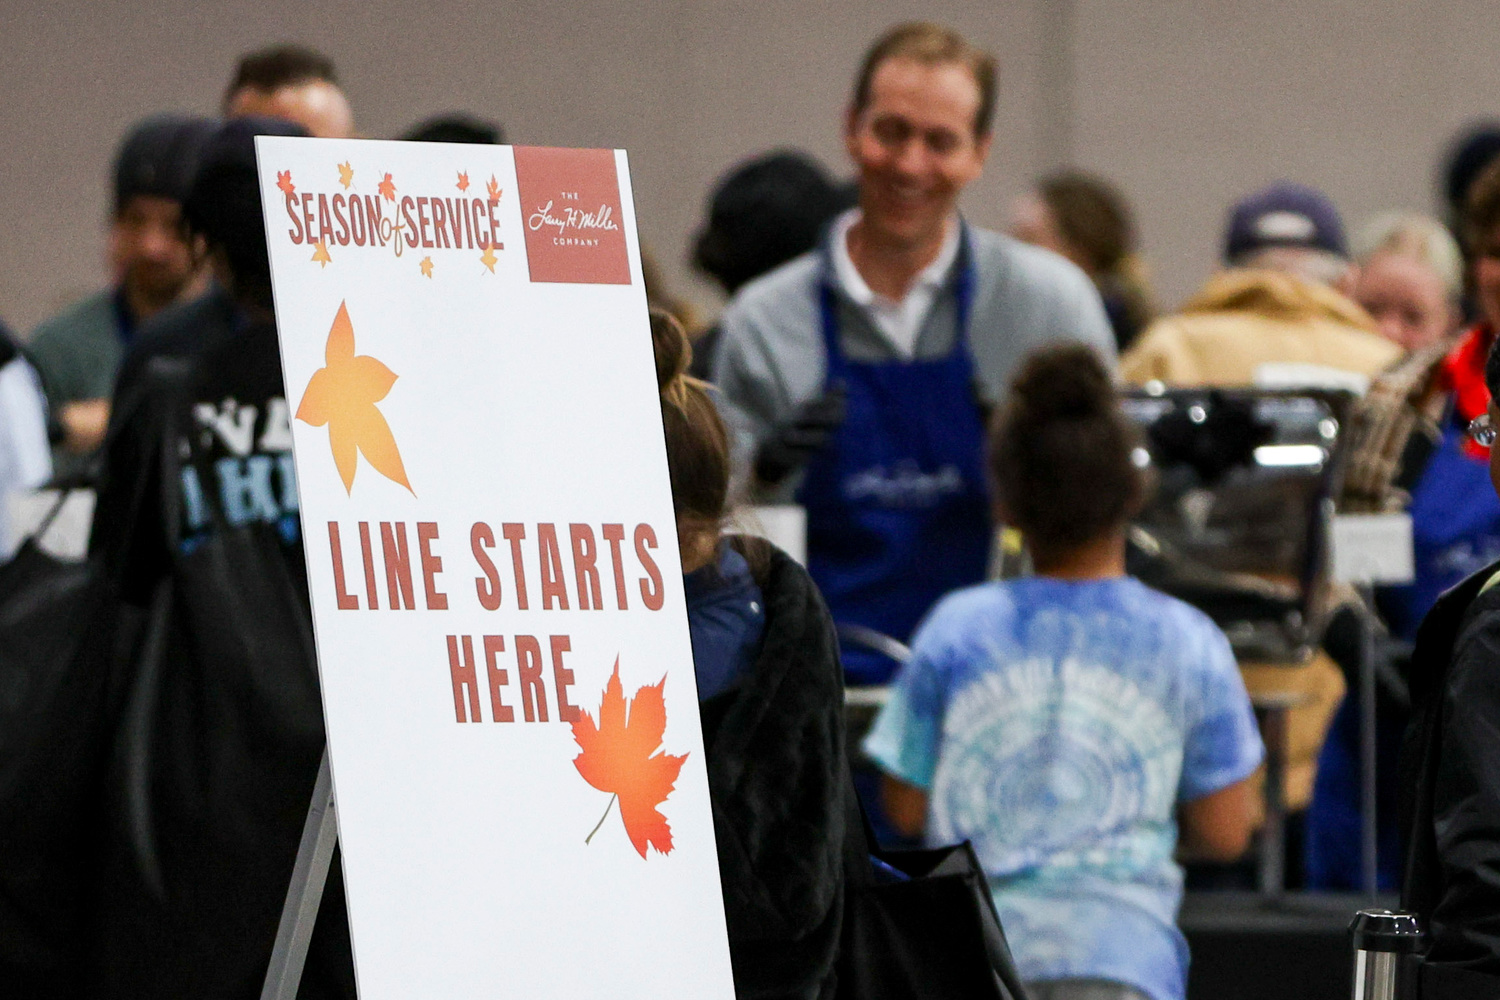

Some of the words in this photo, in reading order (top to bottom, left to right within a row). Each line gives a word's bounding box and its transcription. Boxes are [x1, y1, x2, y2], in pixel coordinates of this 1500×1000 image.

[528, 200, 566, 235] Larry
[577, 203, 619, 231] Miller
[561, 191, 580, 200] THE
[285, 192, 386, 247] SEASON
[381, 203, 406, 257] of
[401, 195, 505, 251] SERVICE
[552, 237, 600, 247] COMPANY
[327, 521, 449, 611] LINE
[470, 521, 665, 612] STARTS
[446, 634, 581, 724] HERE
